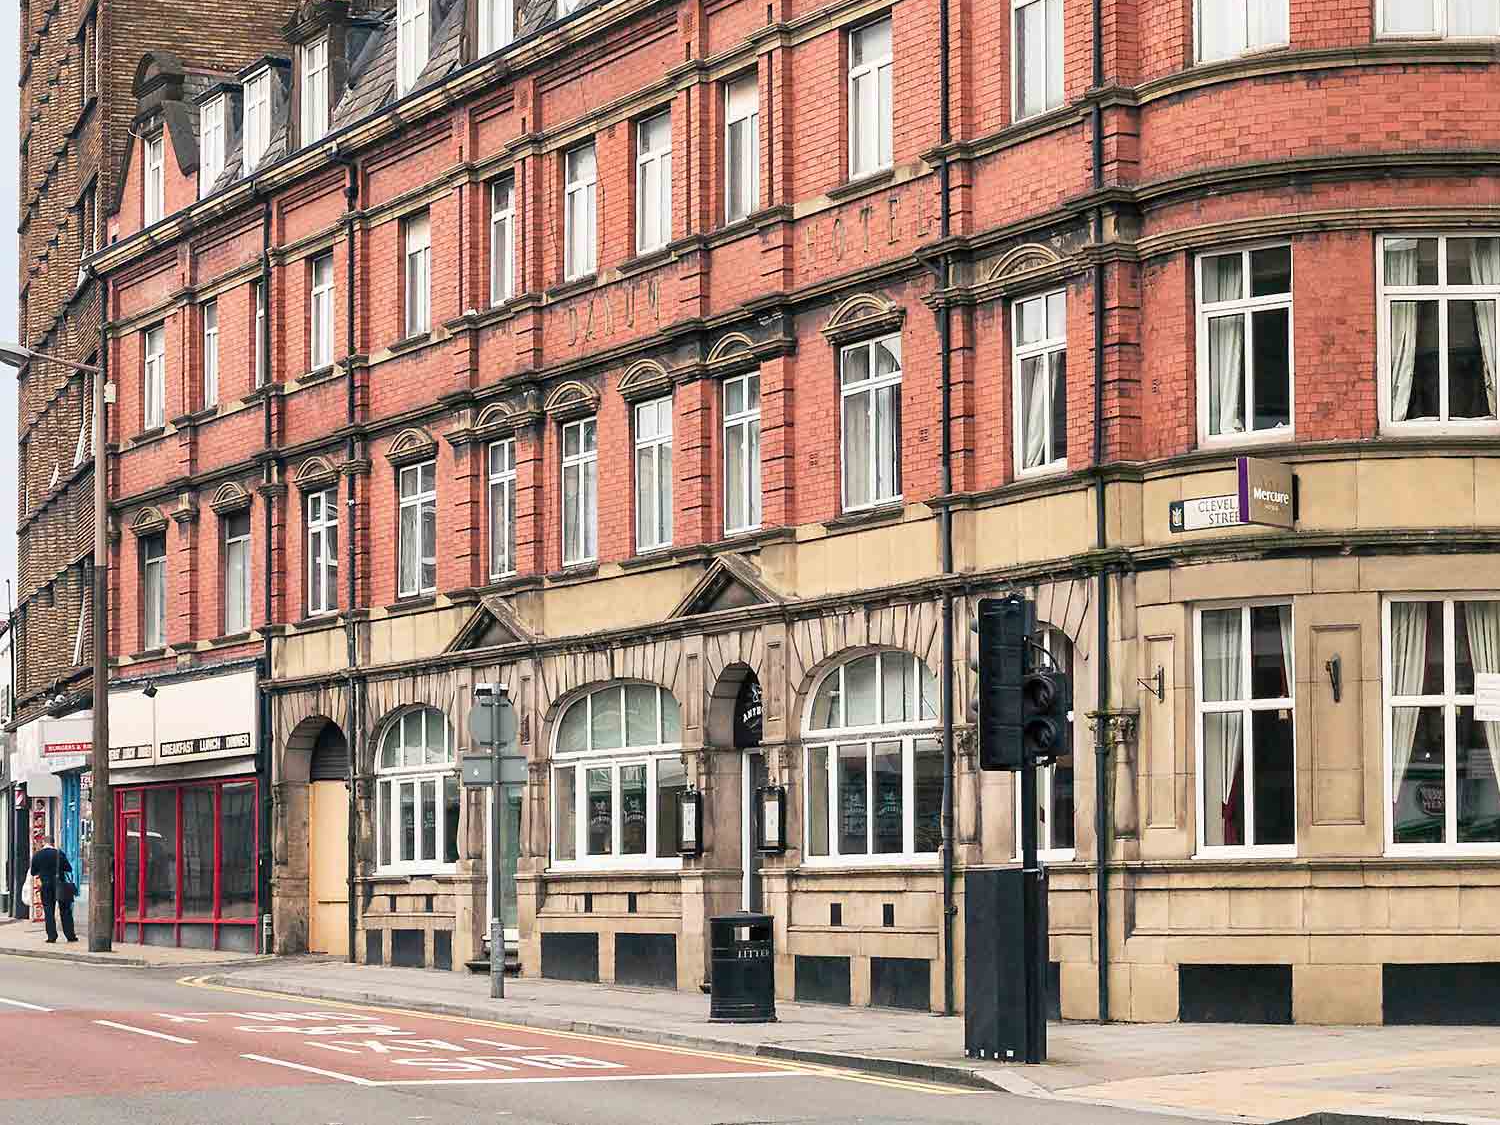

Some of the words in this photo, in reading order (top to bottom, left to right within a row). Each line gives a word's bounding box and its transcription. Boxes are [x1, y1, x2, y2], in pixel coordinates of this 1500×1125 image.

[1199, 496, 1239, 513] CLEVEL
[1253, 486, 1290, 505] Mercure
[1208, 510, 1240, 525] STREE
[390, 1054, 629, 1073] BUS
